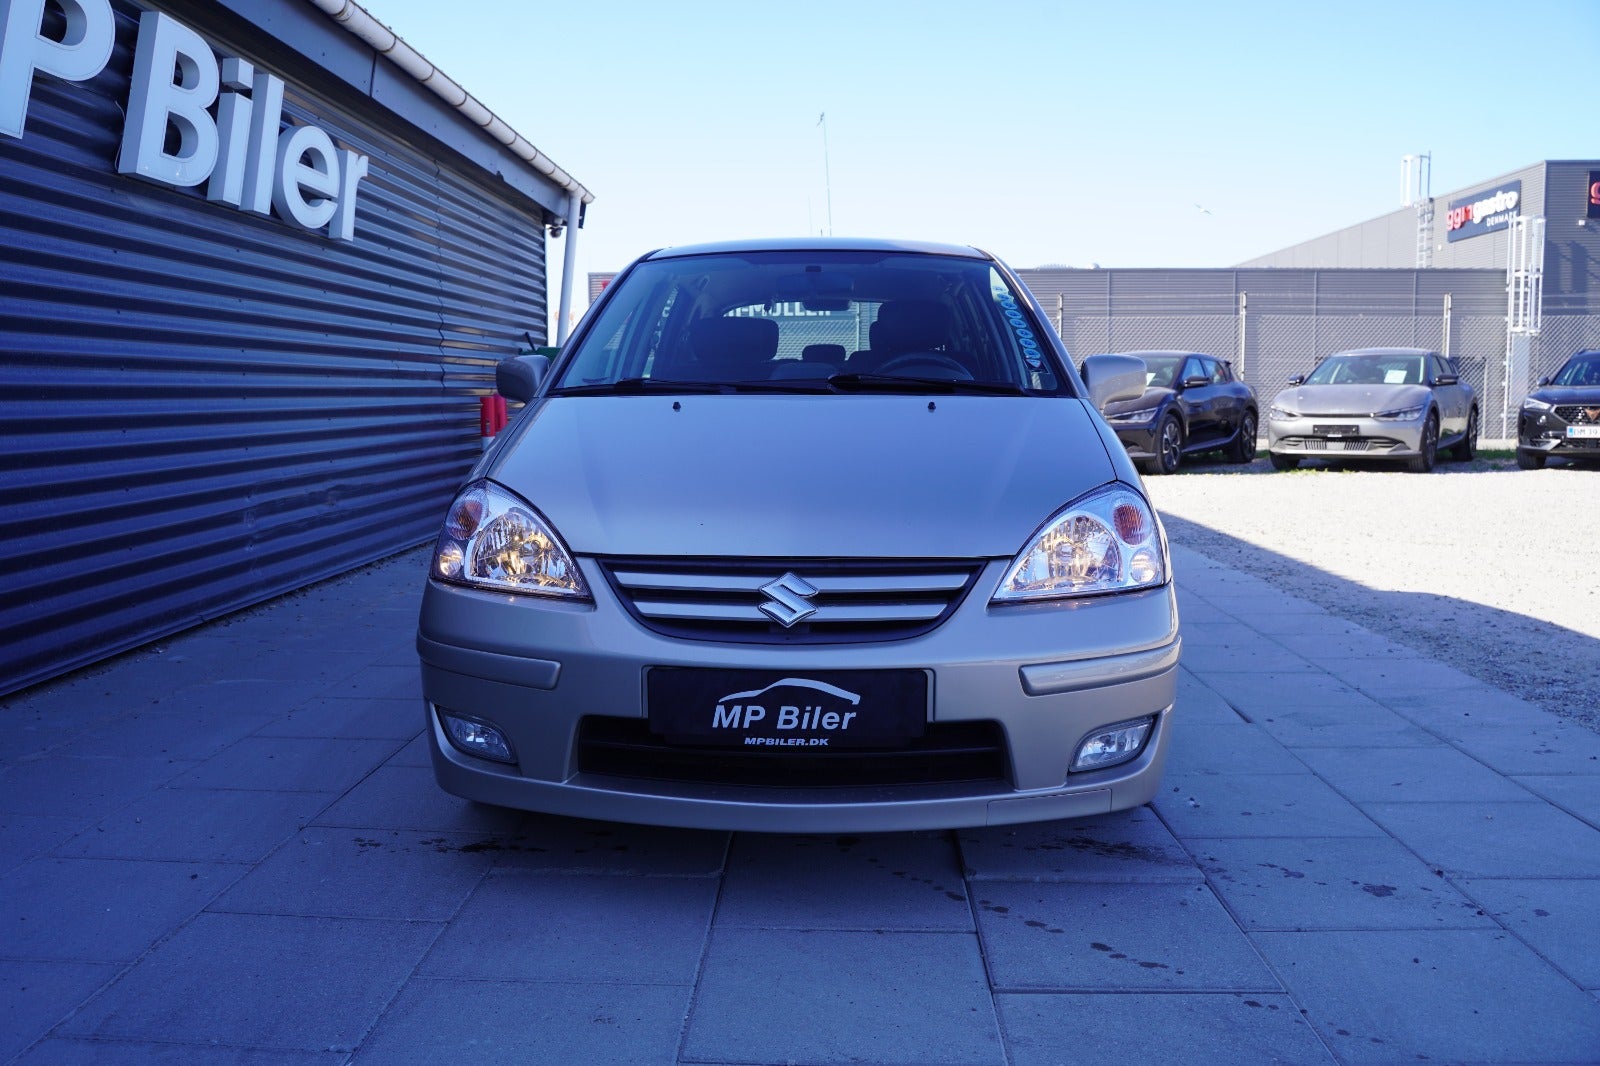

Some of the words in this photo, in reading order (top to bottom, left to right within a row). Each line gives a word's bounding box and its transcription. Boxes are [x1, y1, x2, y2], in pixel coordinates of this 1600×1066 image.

[118, 11, 369, 241] Biler
[712, 704, 766, 729] MP
[776, 704, 857, 730] Biler
[744, 737, 829, 746] MPBILER.DK
